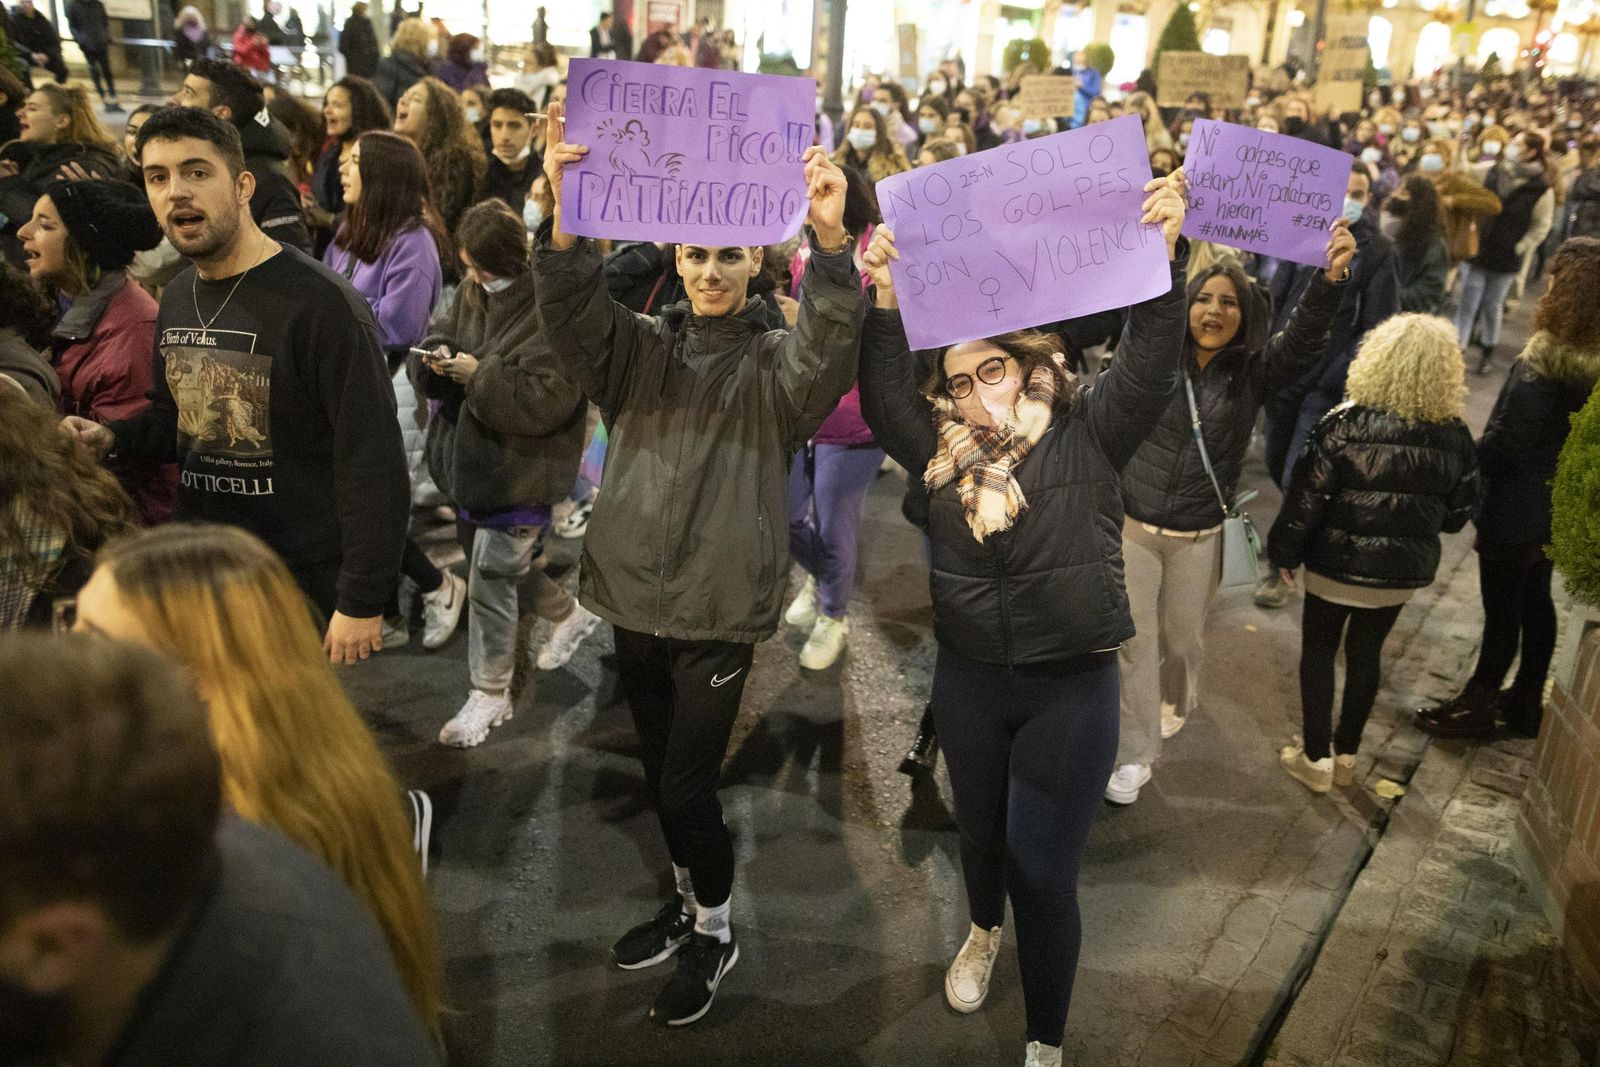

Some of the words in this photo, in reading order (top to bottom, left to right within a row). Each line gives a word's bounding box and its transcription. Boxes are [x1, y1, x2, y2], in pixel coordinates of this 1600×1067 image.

[709, 81, 749, 122] EL
[888, 172, 952, 218] NO
[1004, 134, 1114, 186] SOLO
[960, 164, 994, 188] 25-N
[1236, 136, 1286, 180] golpes
[1288, 156, 1321, 182] que
[922, 209, 983, 245] LOS
[1003, 167, 1132, 224] GOLPES
[1188, 196, 1205, 210] ue
[1216, 197, 1267, 225] hieran.
[1268, 181, 1331, 211] palabras
[905, 255, 971, 296] SON
[180, 332, 191, 343] of
[182, 470, 274, 495] OTTICELLI
